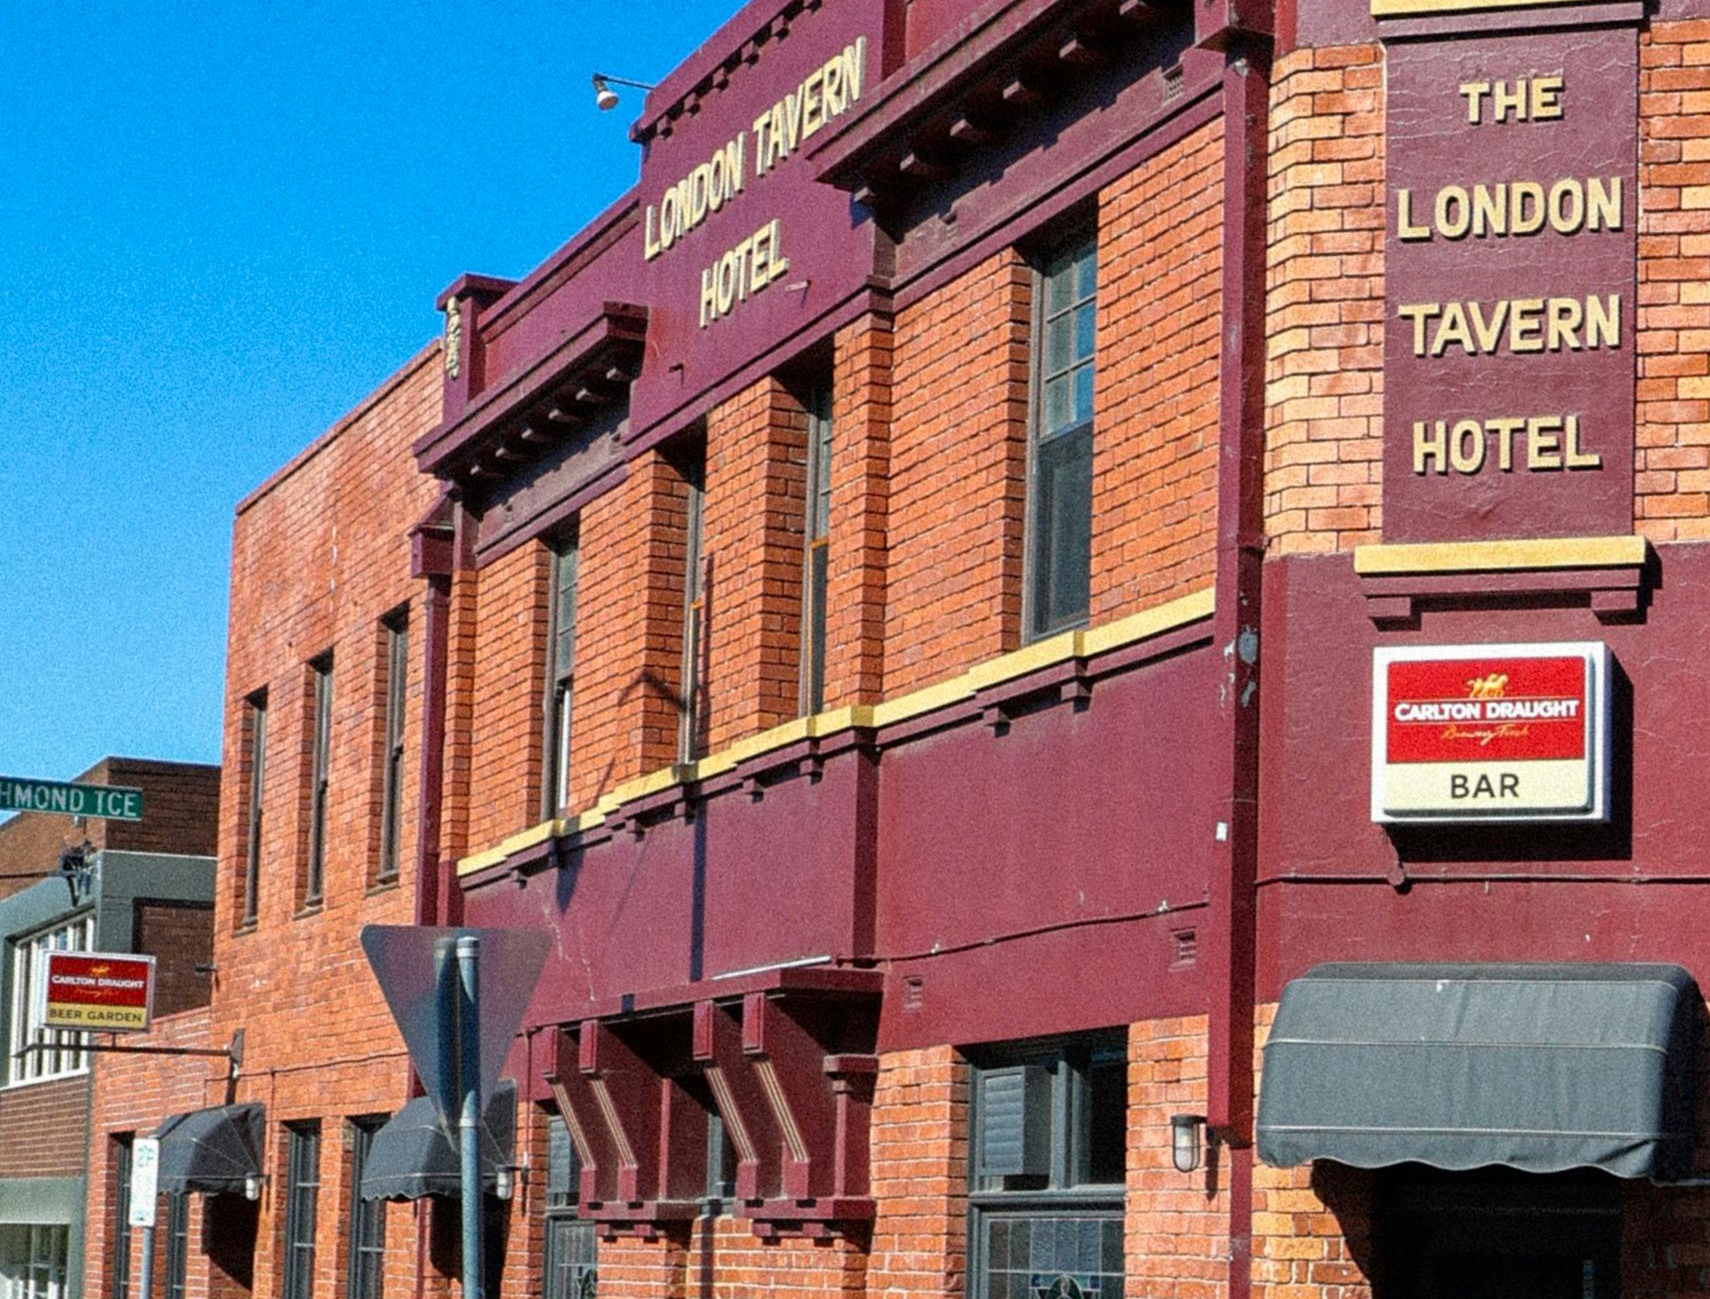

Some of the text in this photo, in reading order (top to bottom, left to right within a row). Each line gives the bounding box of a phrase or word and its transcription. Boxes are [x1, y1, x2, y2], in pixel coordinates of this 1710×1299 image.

[1460, 76, 1564, 123] THE
[645, 36, 867, 260] LONDON TAVERN
[1397, 176, 1623, 240] LONDON
[700, 218, 790, 329] HOTEL
[1397, 294, 1621, 356] TAVERN
[1412, 414, 1602, 474] HOTEL
[1394, 699, 1580, 722] CARLTON DRAUGHT
[94, 790, 137, 817] TCE
[1451, 773, 1520, 799] BAR
[51, 975, 144, 989] CARLTON DRAUGHT
[49, 1008, 142, 1022] BEER GARDEN
